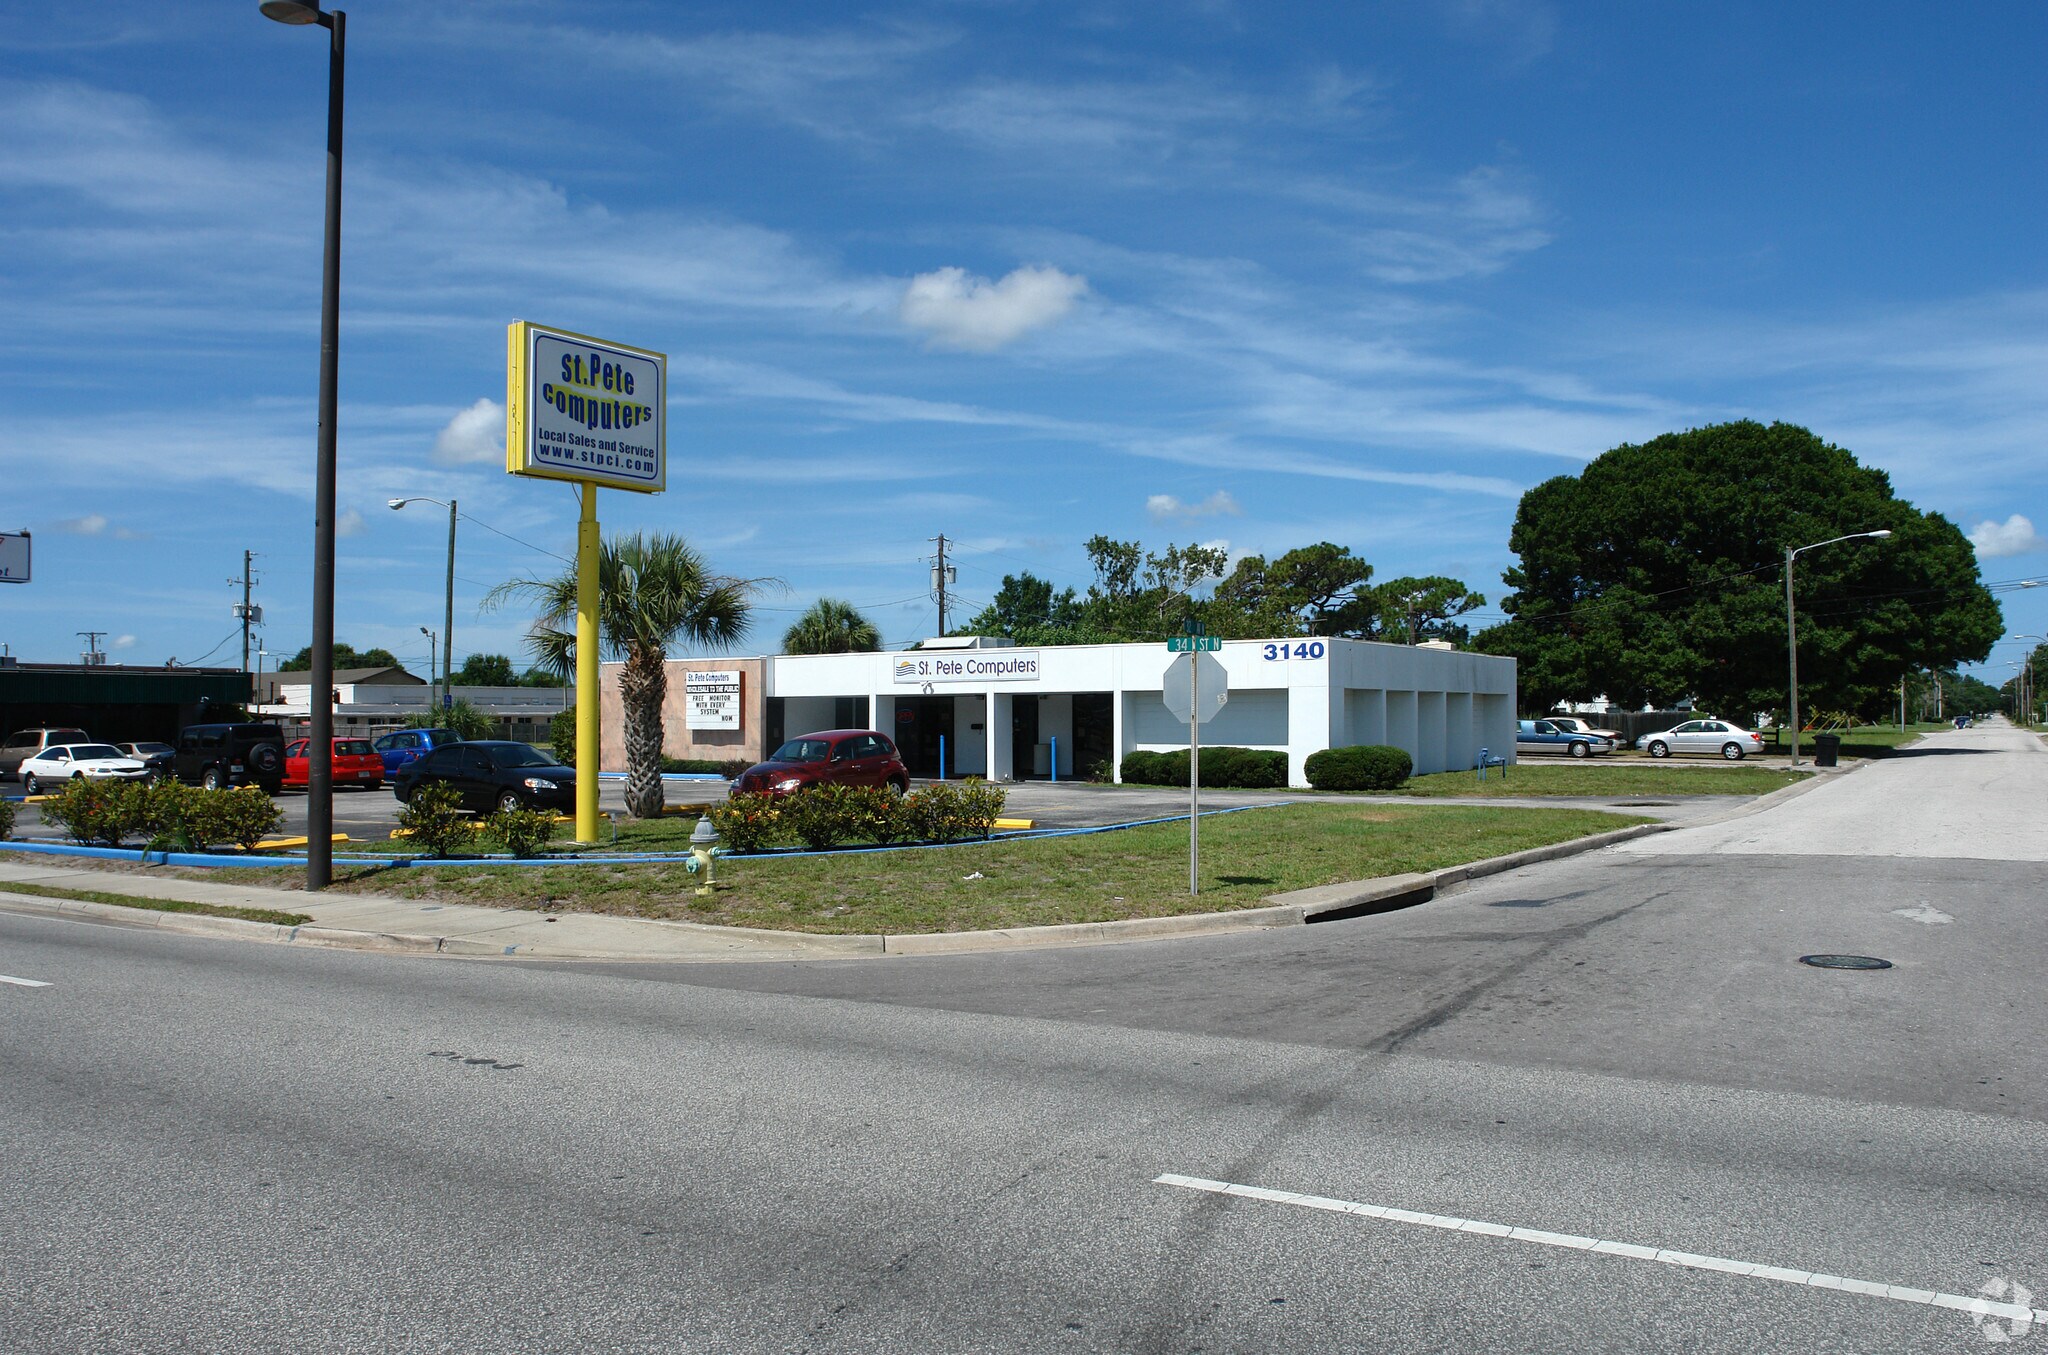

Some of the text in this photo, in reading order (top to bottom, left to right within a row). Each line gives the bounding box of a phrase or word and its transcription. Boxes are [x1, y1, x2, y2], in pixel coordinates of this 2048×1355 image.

[538, 427, 655, 458] Local Sales and Service
[539, 443, 654, 473] www.stpci.com
[1175, 637, 1219, 651] 34 ST N
[1263, 641, 1325, 661] 3140
[918, 658, 1037, 677] St. Pete Computers
[695, 673, 705, 682] Pete
[706, 673, 729, 683] Computers
[709, 694, 731, 702] MONITOR
[710, 701, 726, 709] EVERY
[700, 708, 720, 716] SYSTEM
